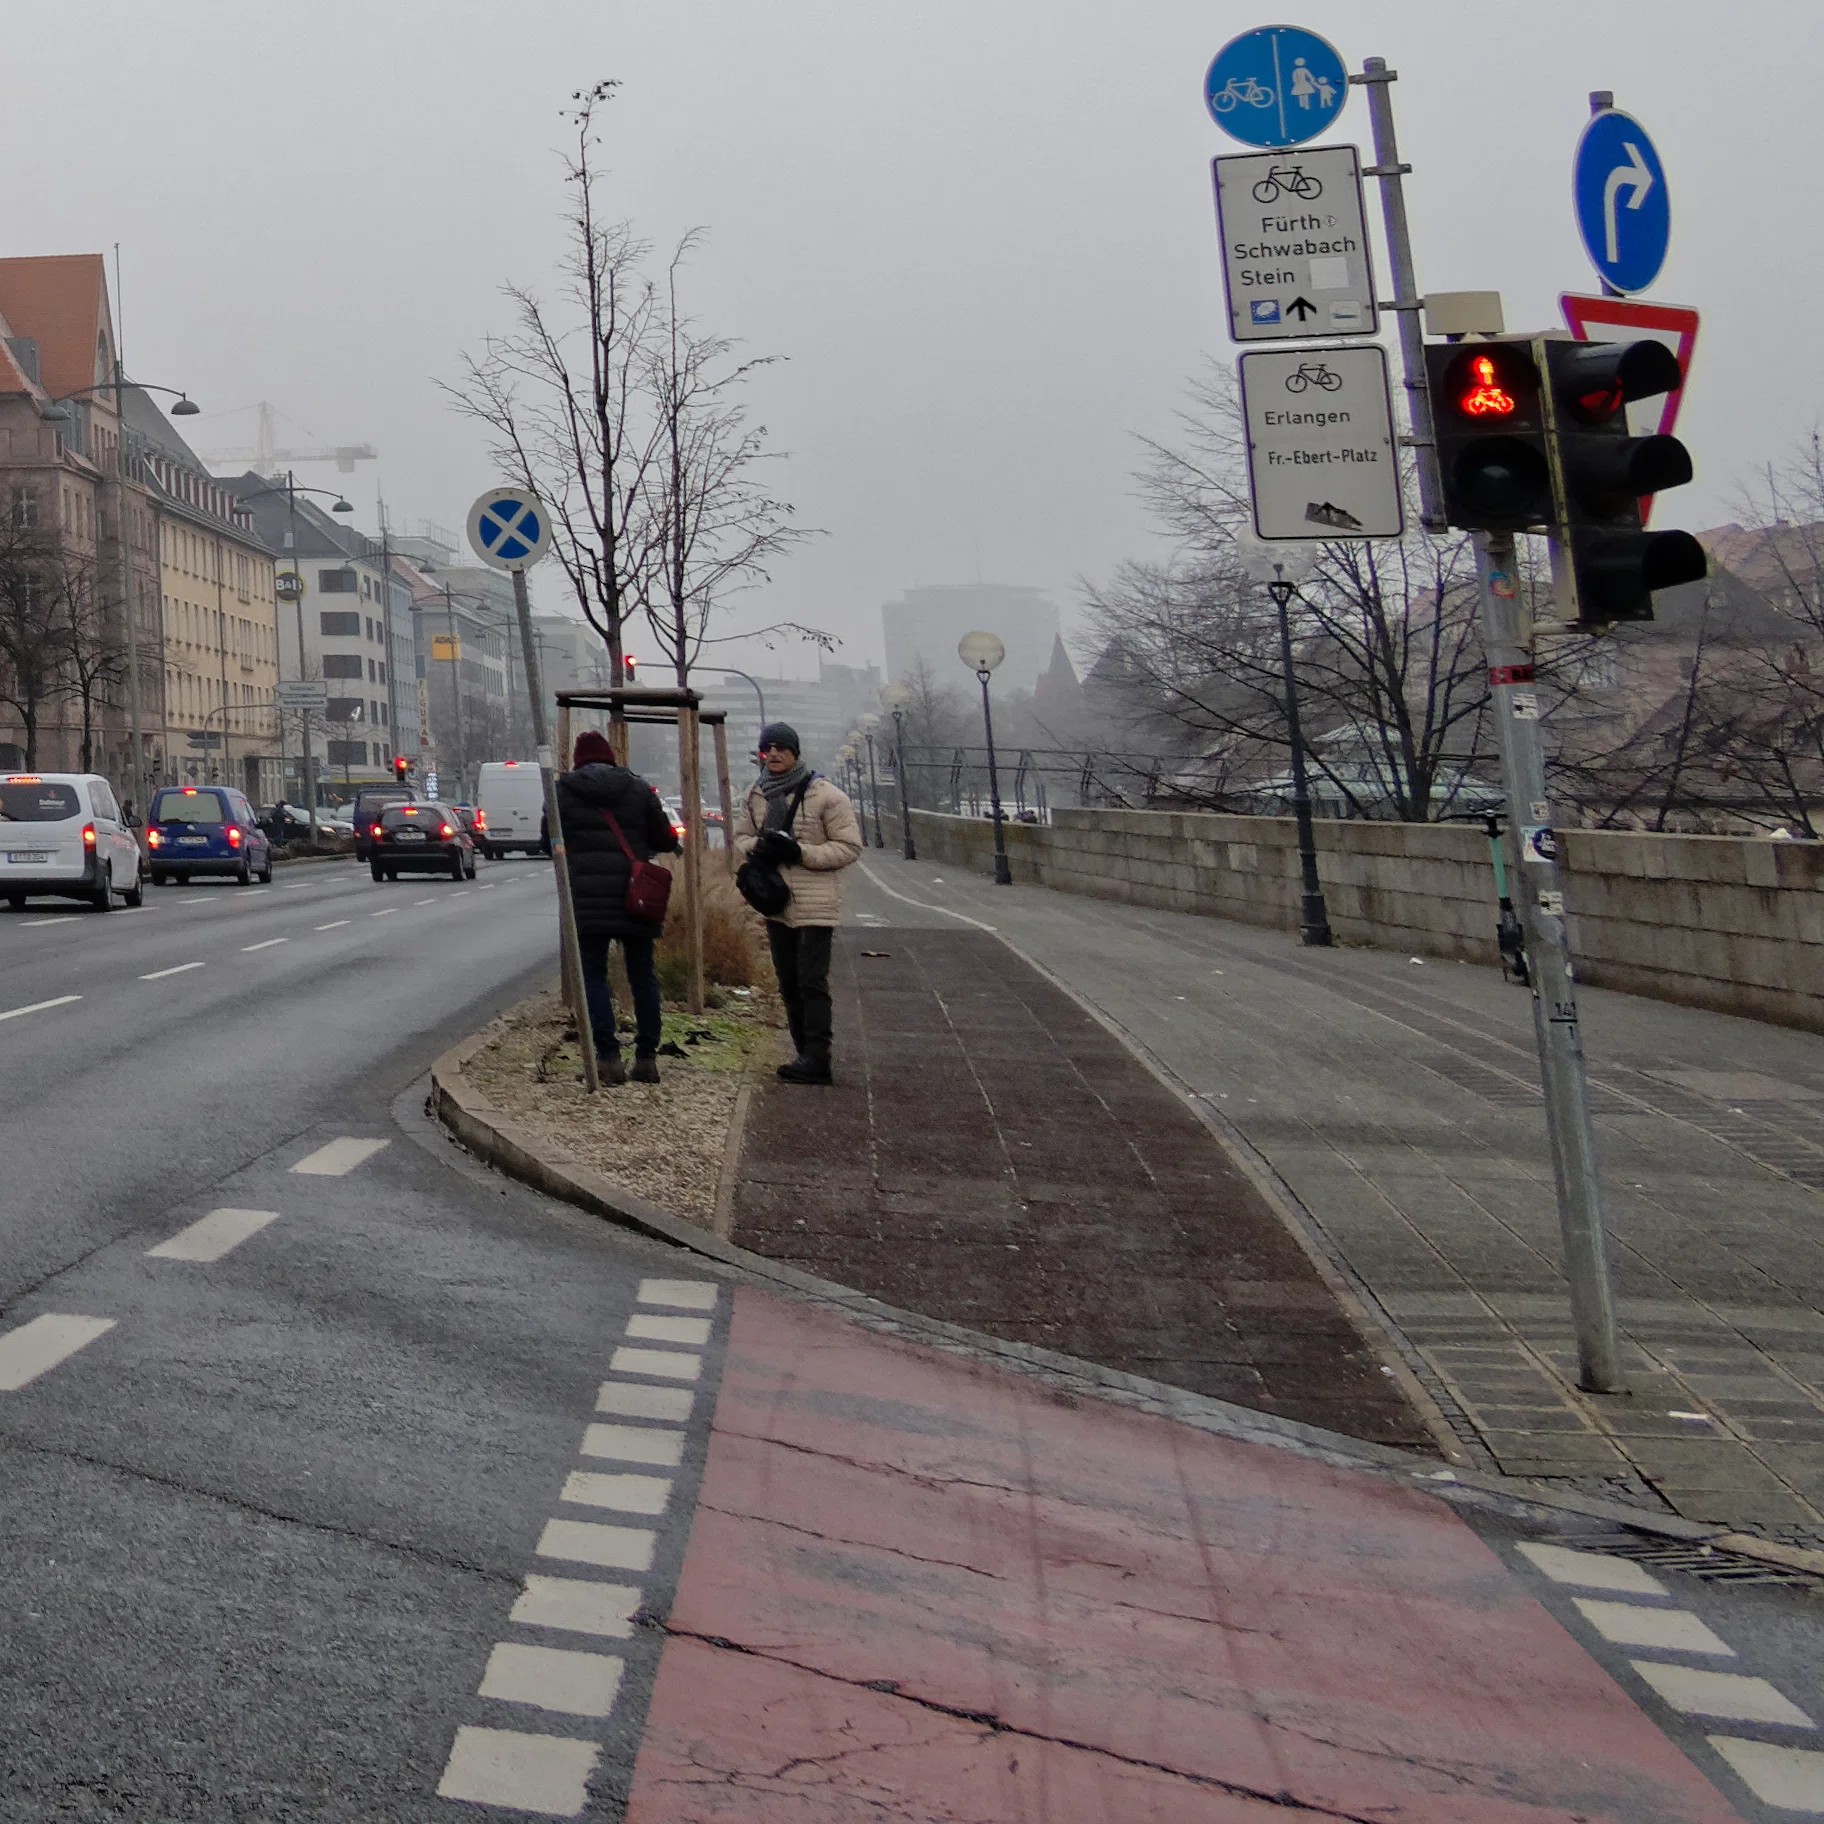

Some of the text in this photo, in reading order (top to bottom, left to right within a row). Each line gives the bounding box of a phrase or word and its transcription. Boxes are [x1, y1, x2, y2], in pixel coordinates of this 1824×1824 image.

[1261, 213, 1321, 234] Fürth
[1234, 236, 1356, 260] Schwabach
[1240, 268, 1295, 287] Stein
[1265, 411, 1350, 429] Erlangen
[1268, 448, 1378, 465] Fr.-Ebert-Platz
